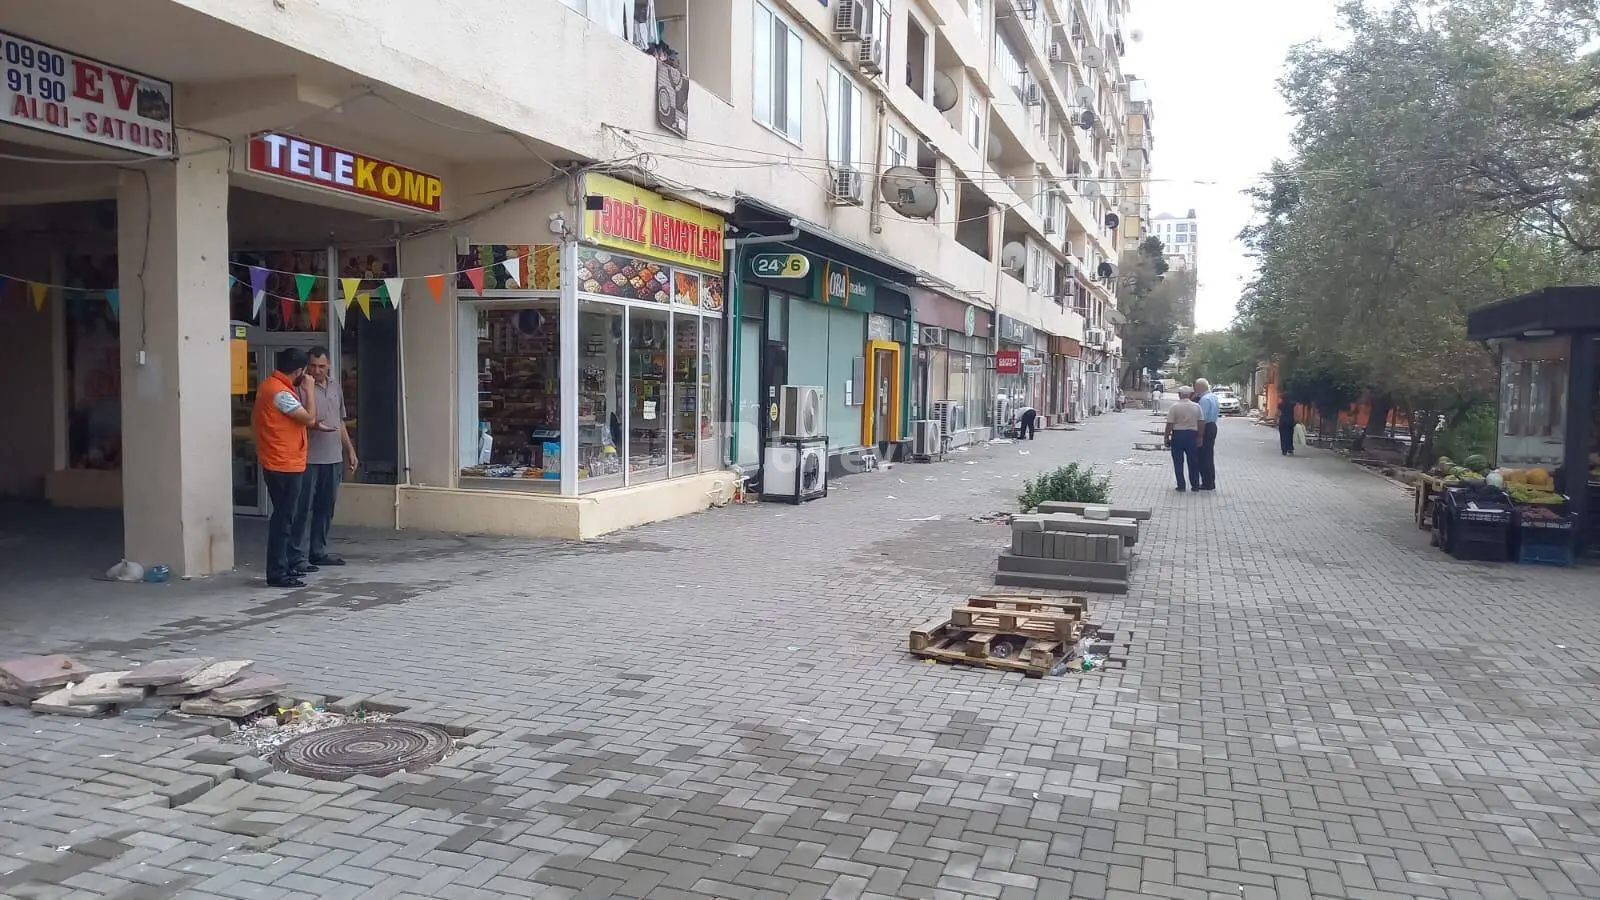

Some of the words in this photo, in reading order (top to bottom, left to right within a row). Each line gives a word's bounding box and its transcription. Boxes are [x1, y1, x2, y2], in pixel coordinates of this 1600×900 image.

[0, 40, 65, 77] 0990
[72, 59, 139, 111] EV
[263, 132, 441, 206] TELEKOMP
